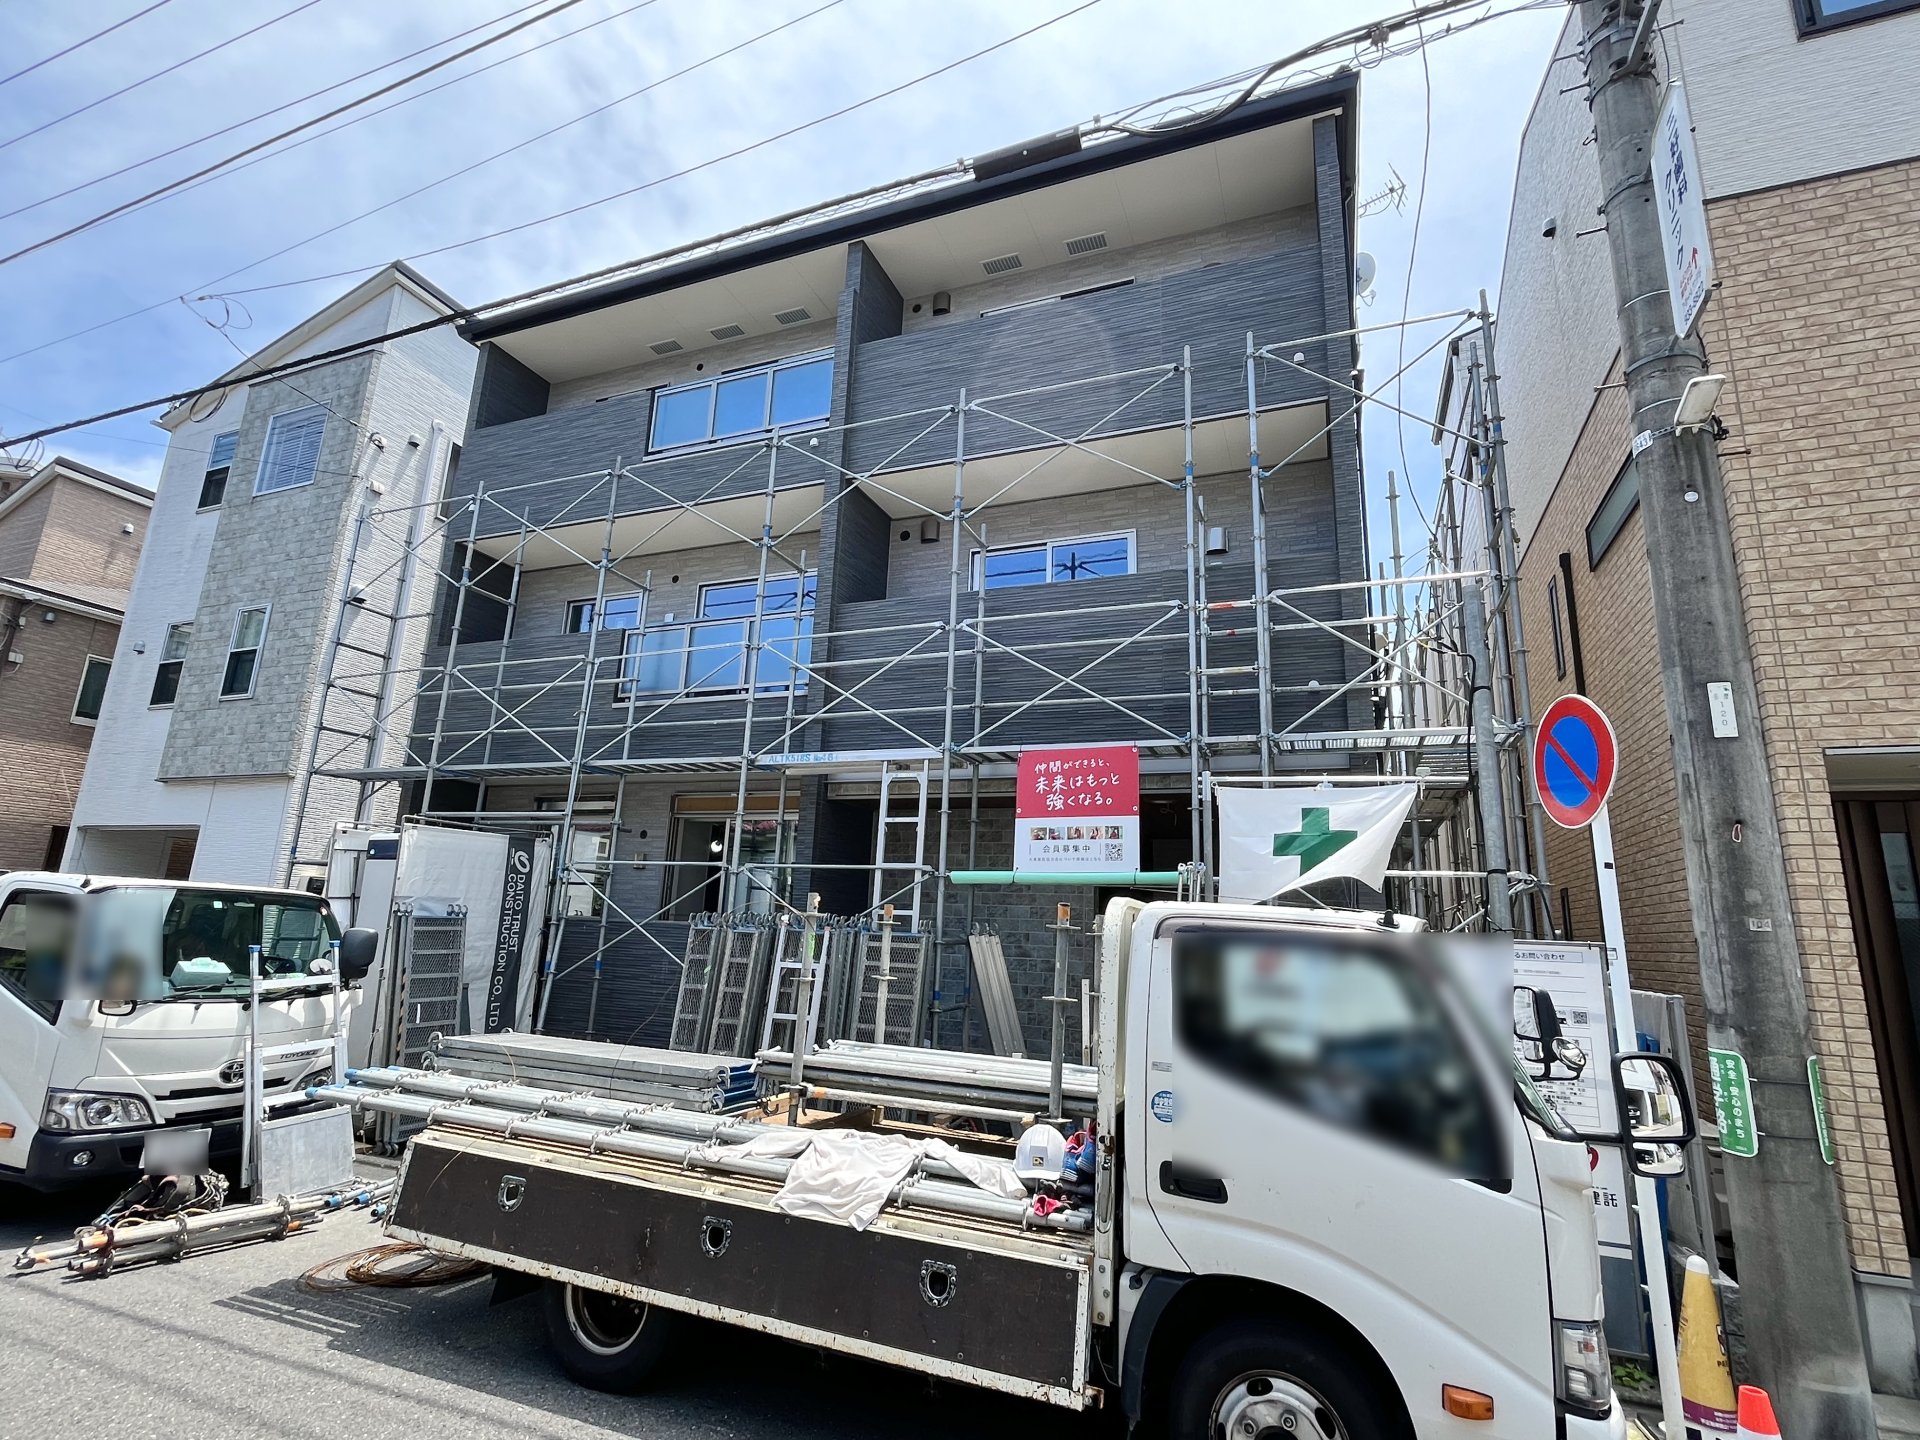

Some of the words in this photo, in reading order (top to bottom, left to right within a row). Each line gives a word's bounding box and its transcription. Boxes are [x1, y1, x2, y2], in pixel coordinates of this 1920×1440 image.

[1665, 168, 1684, 271] クリニック
[1034, 758, 1110, 774] 仲間ができると、
[1035, 773, 1120, 794] 未来はもっと
[1046, 792, 1113, 811] 強くなる。
[1042, 844, 1091, 853] 会員募集中
[514, 874, 526, 910] DAITO
[496, 873, 516, 972] CONSTRUCTION
[509, 913, 522, 953] TRUST
[280, 1049, 319, 1059] TOYOACE
[1725, 1059, 1745, 1139] 安全・安心のまち
